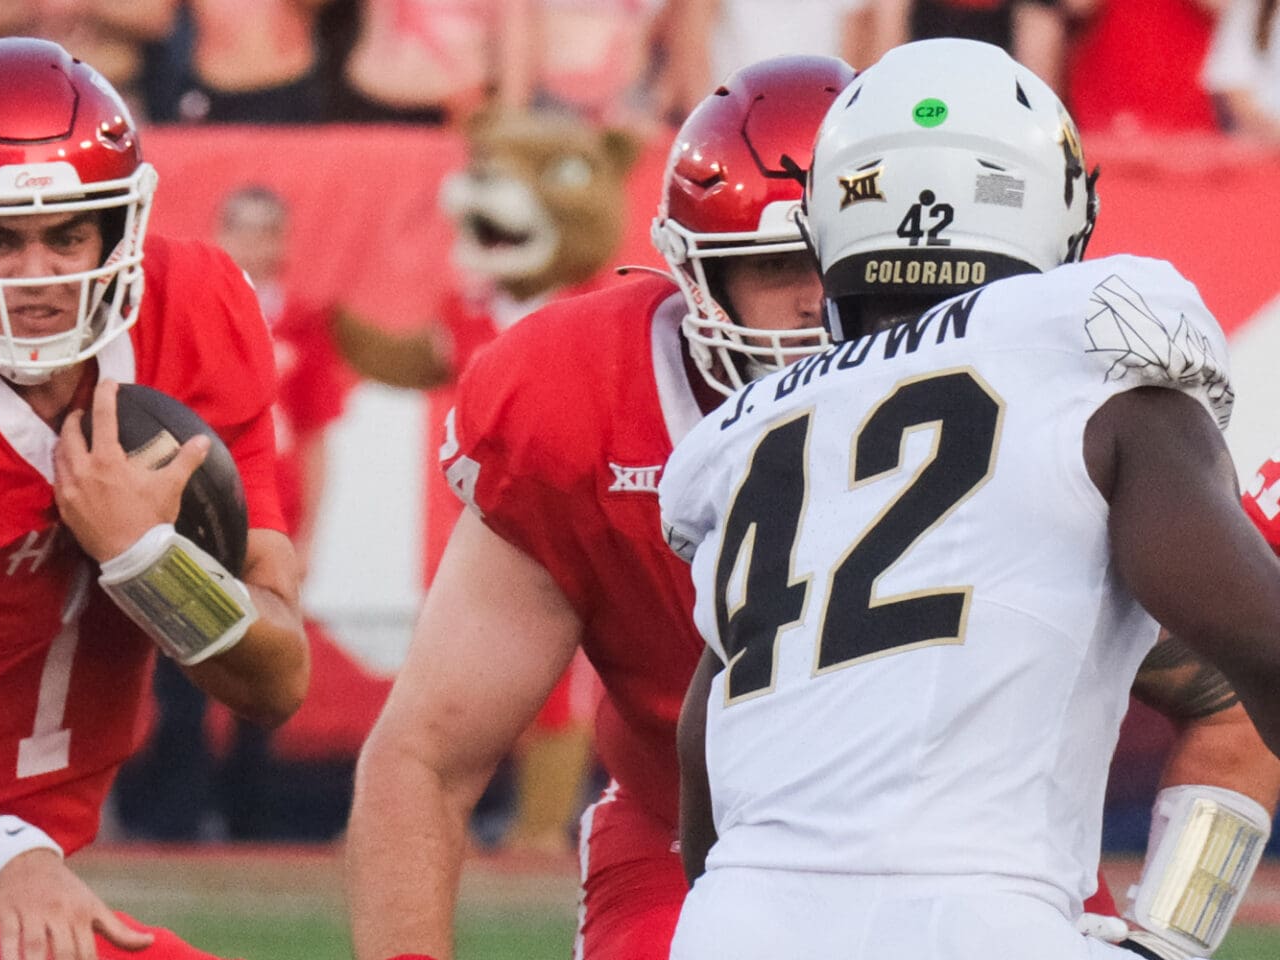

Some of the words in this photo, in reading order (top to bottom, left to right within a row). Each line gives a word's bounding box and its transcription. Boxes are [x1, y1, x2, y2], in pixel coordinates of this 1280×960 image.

[914, 106, 947, 119] C2P
[896, 202, 955, 246] 42
[864, 260, 987, 285] COLORADO
[773, 287, 985, 402] BROWN
[713, 364, 1007, 709] 42
